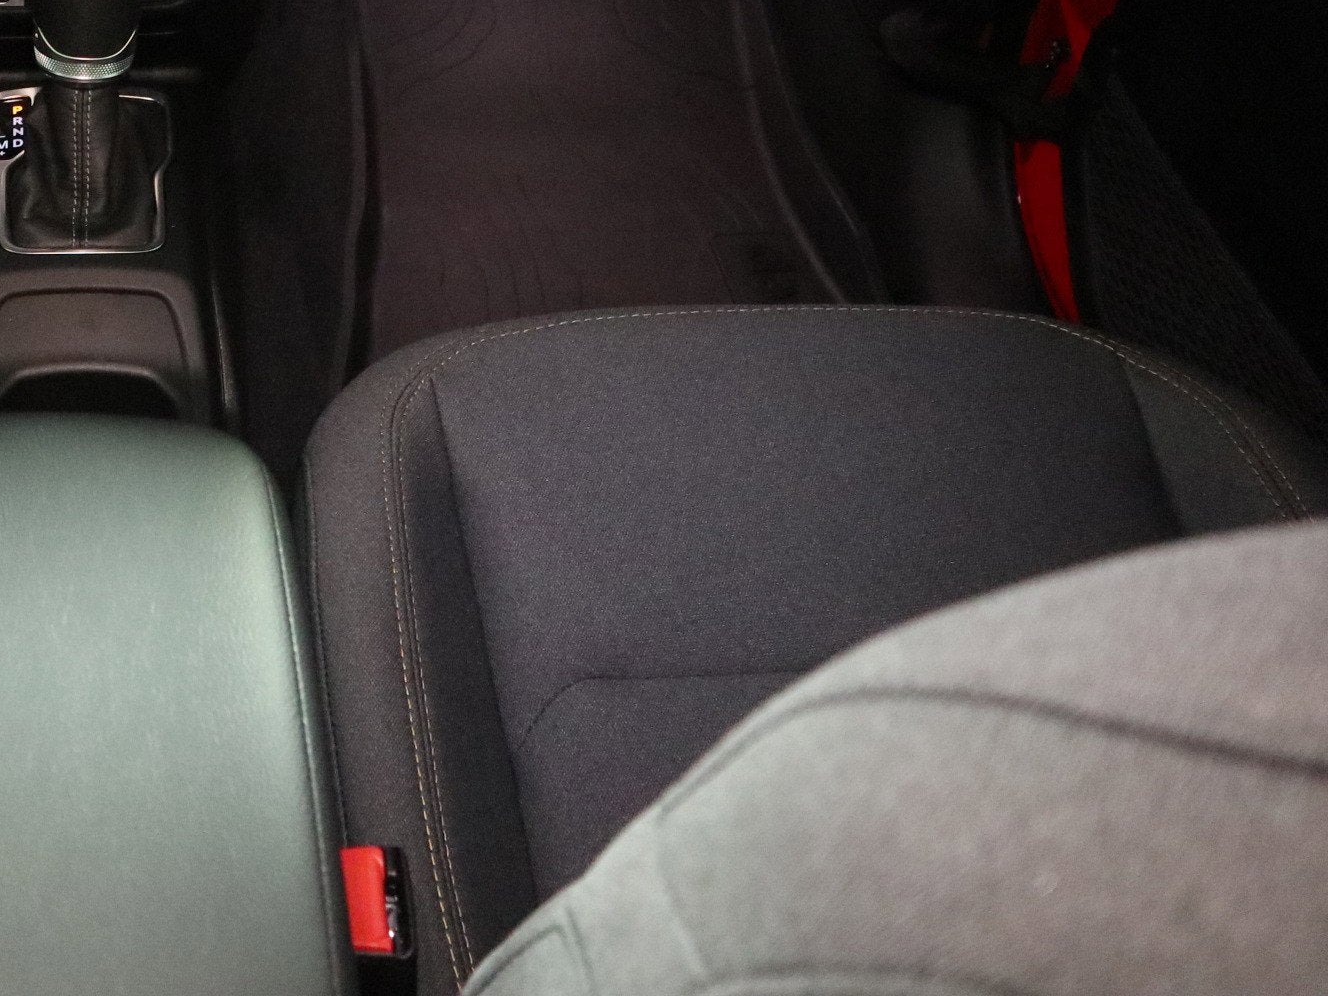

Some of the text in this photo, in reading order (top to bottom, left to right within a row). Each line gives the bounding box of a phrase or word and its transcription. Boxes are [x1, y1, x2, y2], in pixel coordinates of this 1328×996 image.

[13, 106, 23, 115] P
[13, 117, 23, 125] R
[13, 128, 24, 136] N
[13, 139, 24, 148] D
